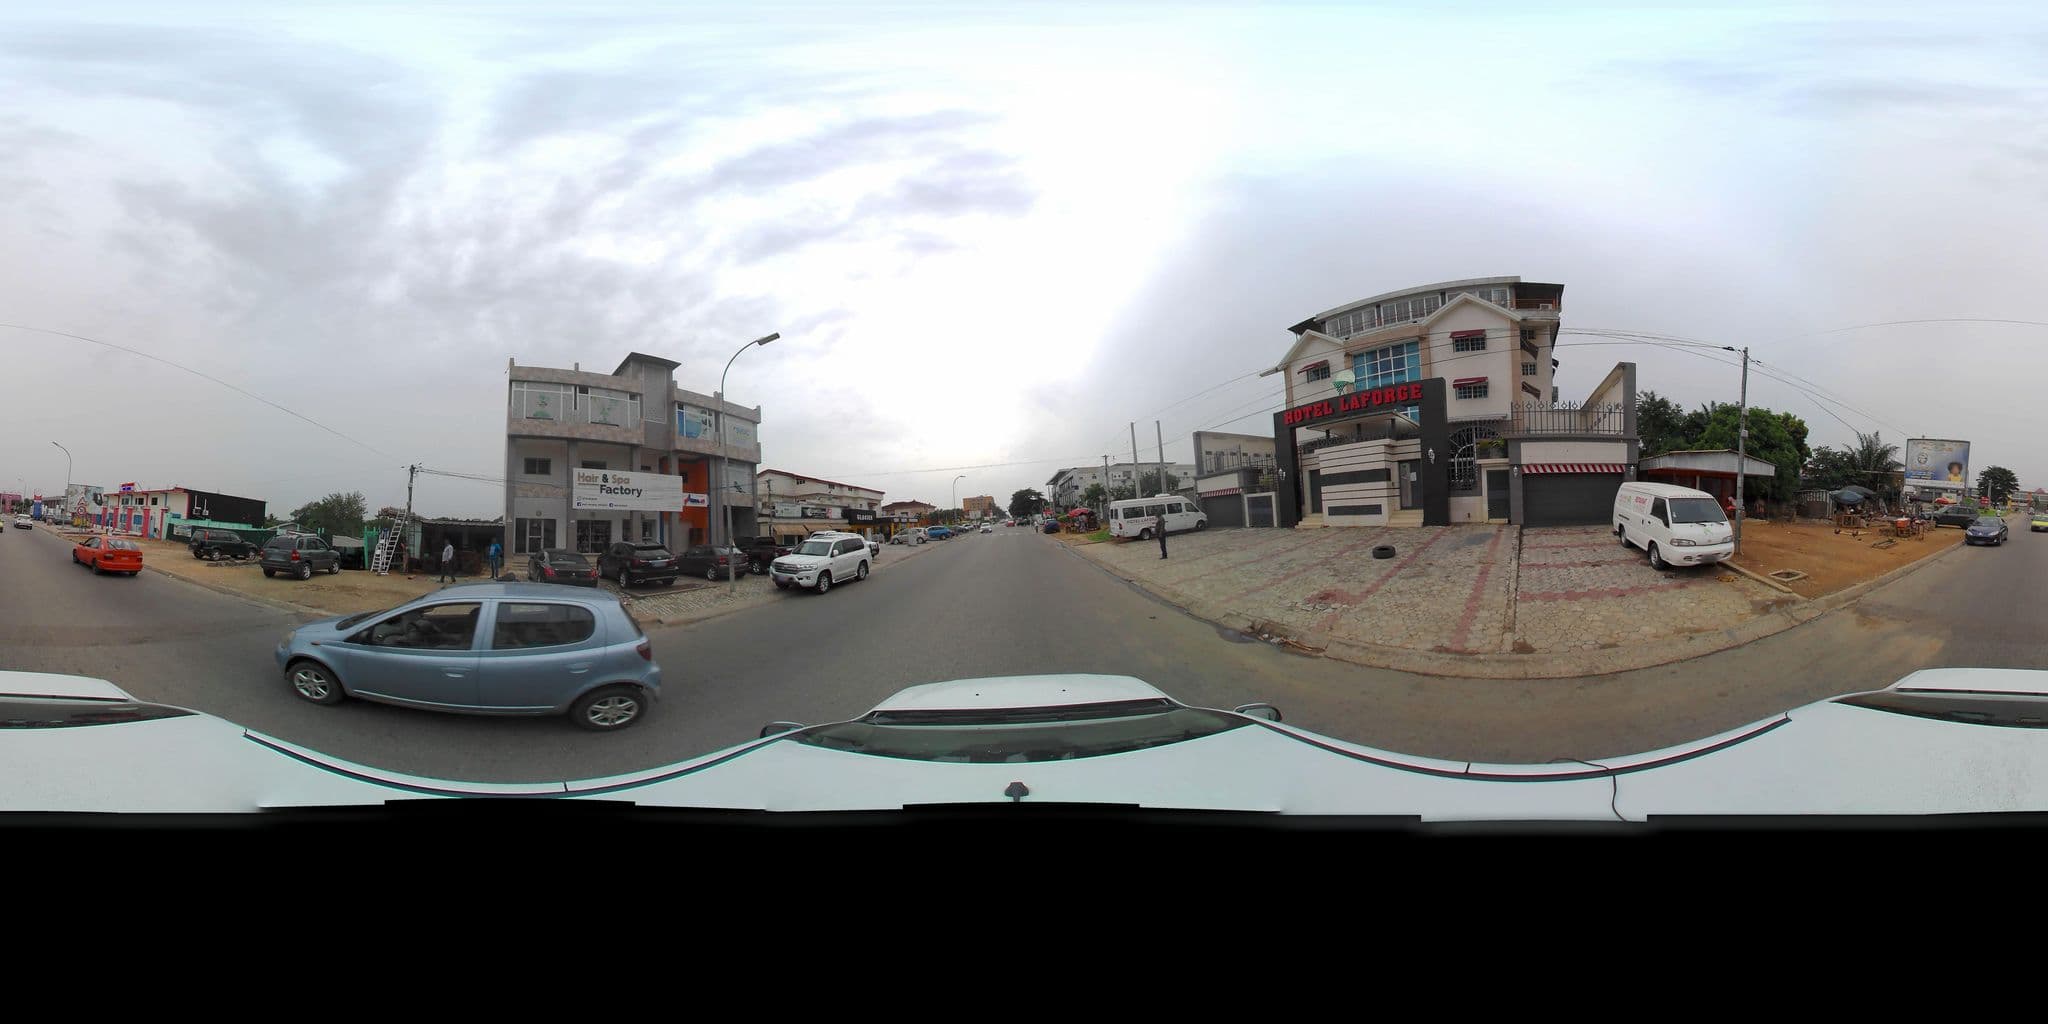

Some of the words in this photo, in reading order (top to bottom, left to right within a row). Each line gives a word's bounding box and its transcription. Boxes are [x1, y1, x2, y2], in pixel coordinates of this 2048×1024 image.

[1284, 402, 1334, 424] HOTEL
[1340, 384, 1423, 411] LAFORGE
[577, 472, 600, 483] Hair
[601, 474, 609, 483] &
[611, 474, 630, 485] Spa
[600, 484, 642, 498] Factory
